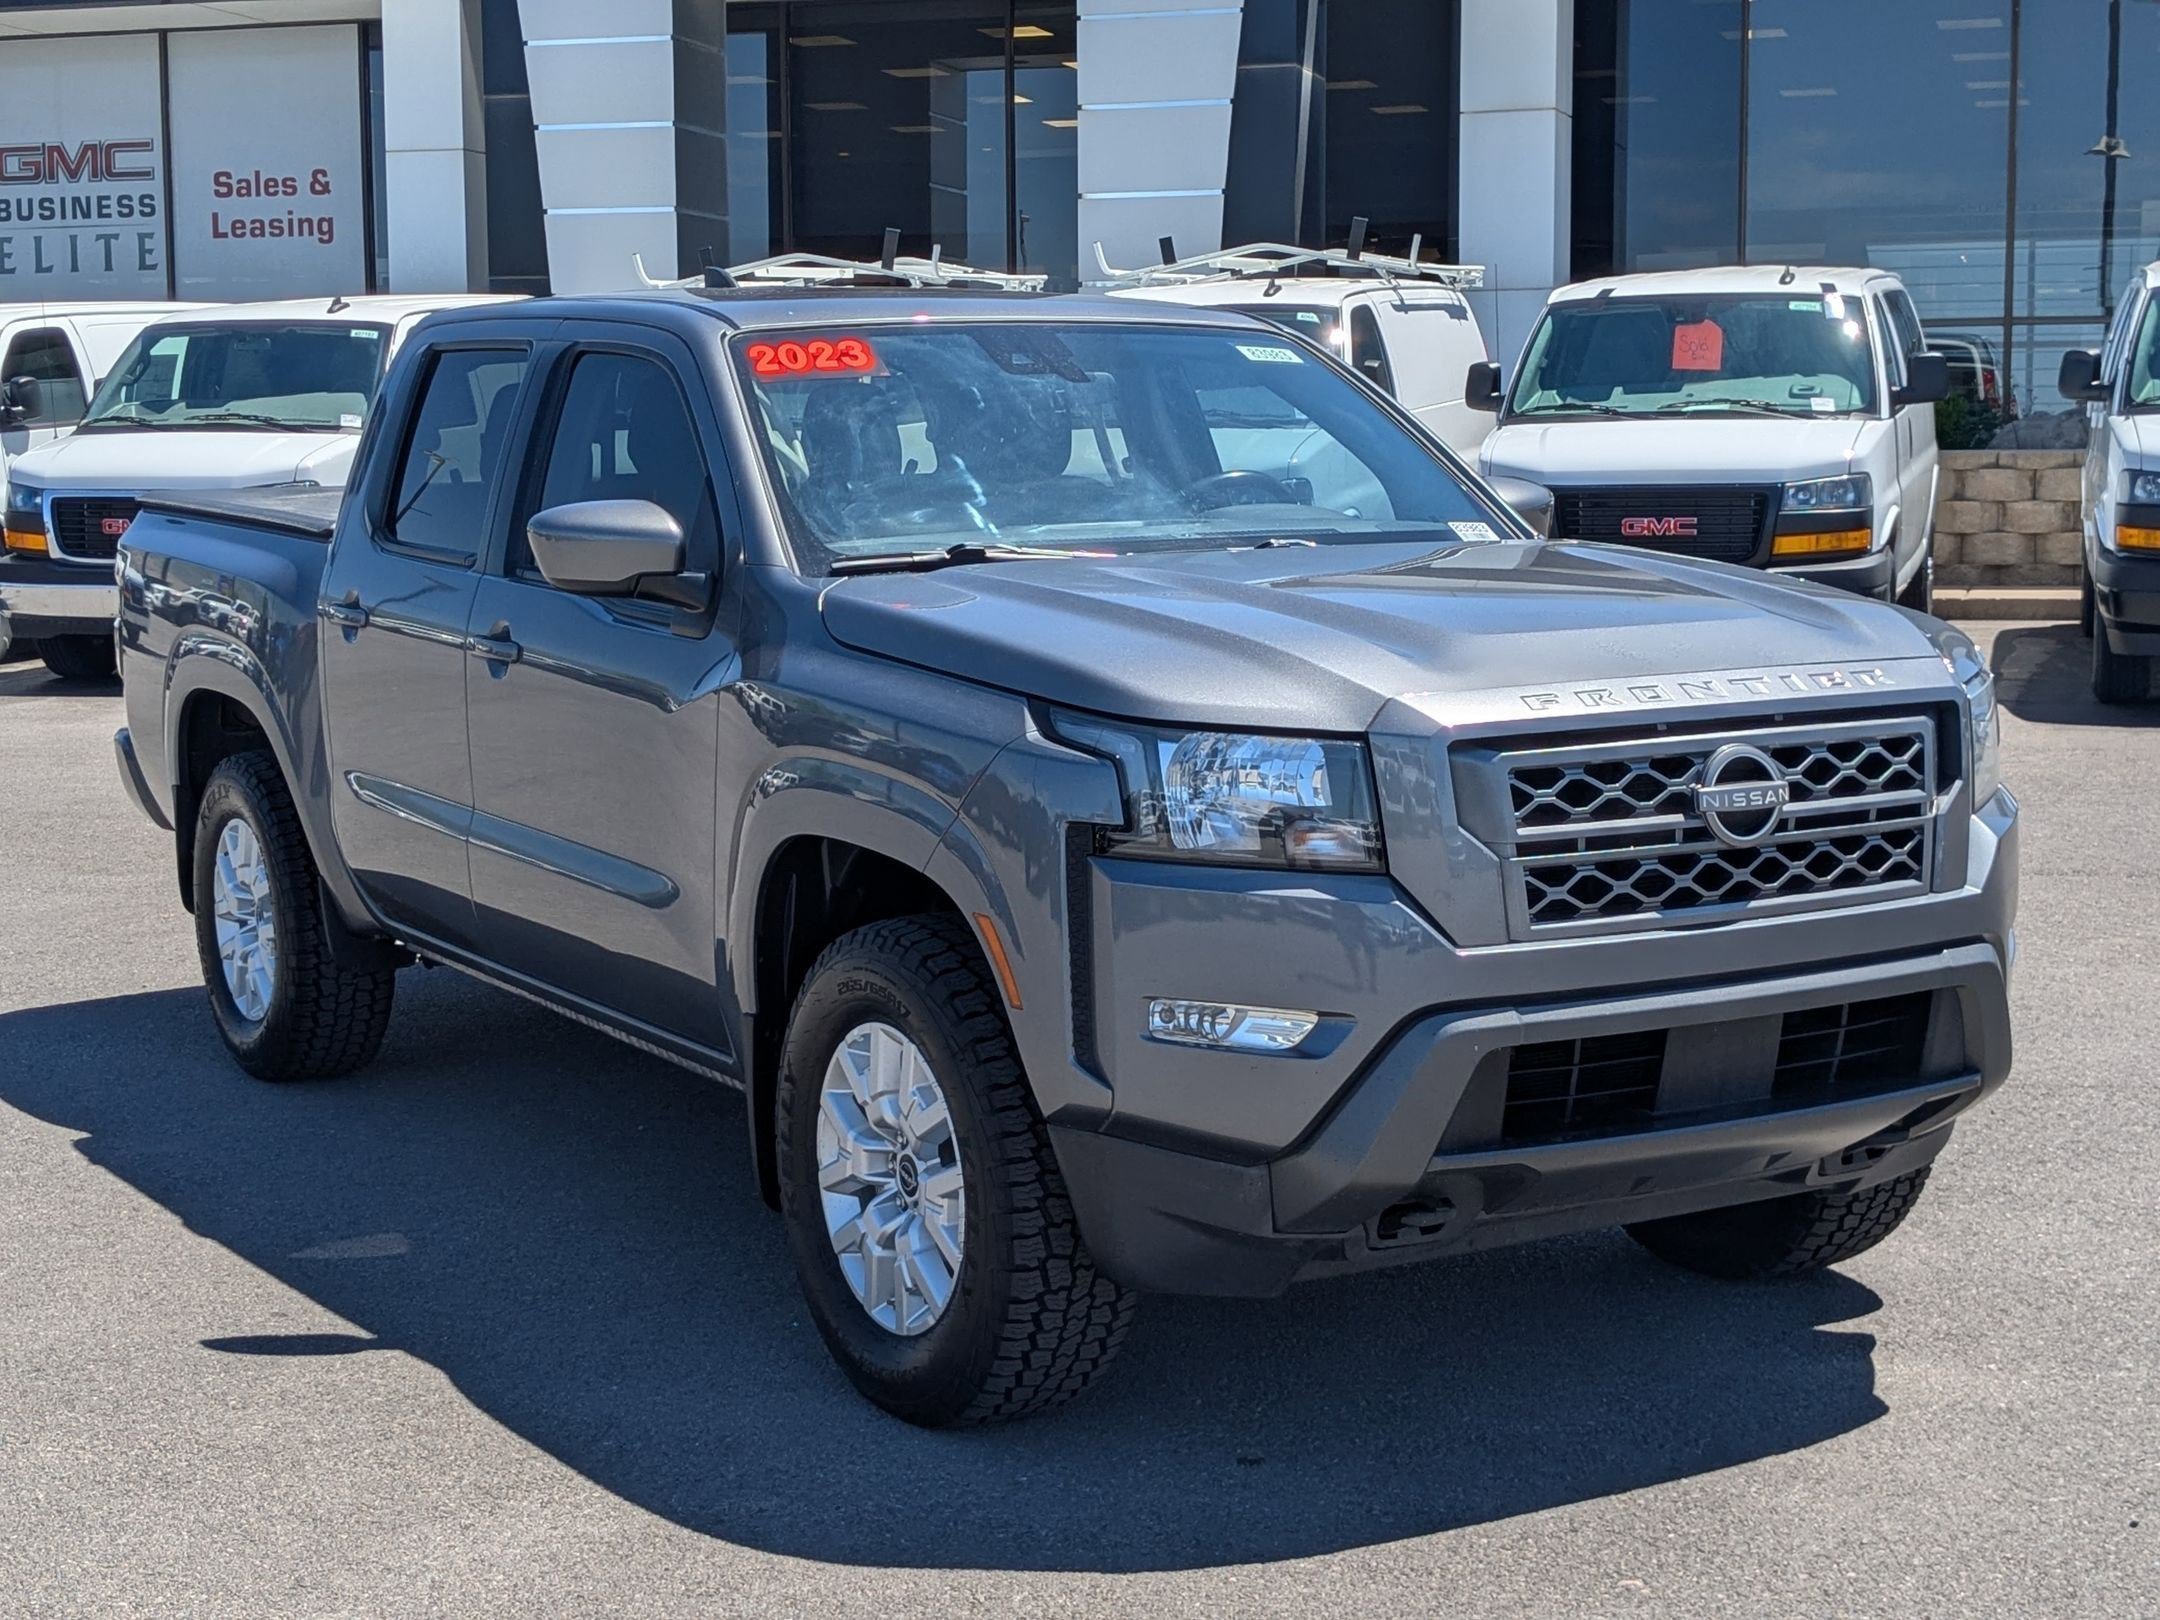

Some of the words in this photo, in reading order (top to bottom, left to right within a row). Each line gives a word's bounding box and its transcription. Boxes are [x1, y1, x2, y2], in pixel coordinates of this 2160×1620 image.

[0, 138, 155, 185] GMC
[213, 170, 298, 198] Sales
[309, 168, 332, 195] &
[0, 194, 156, 222] BUSINESS
[212, 210, 334, 244] Leasing
[0, 232, 159, 275] ELITE
[749, 338, 874, 374] 2023
[1621, 517, 1698, 536] GMC
[1519, 668, 1895, 711] FRONTIER
[1702, 787, 1790, 808] NISSAN
